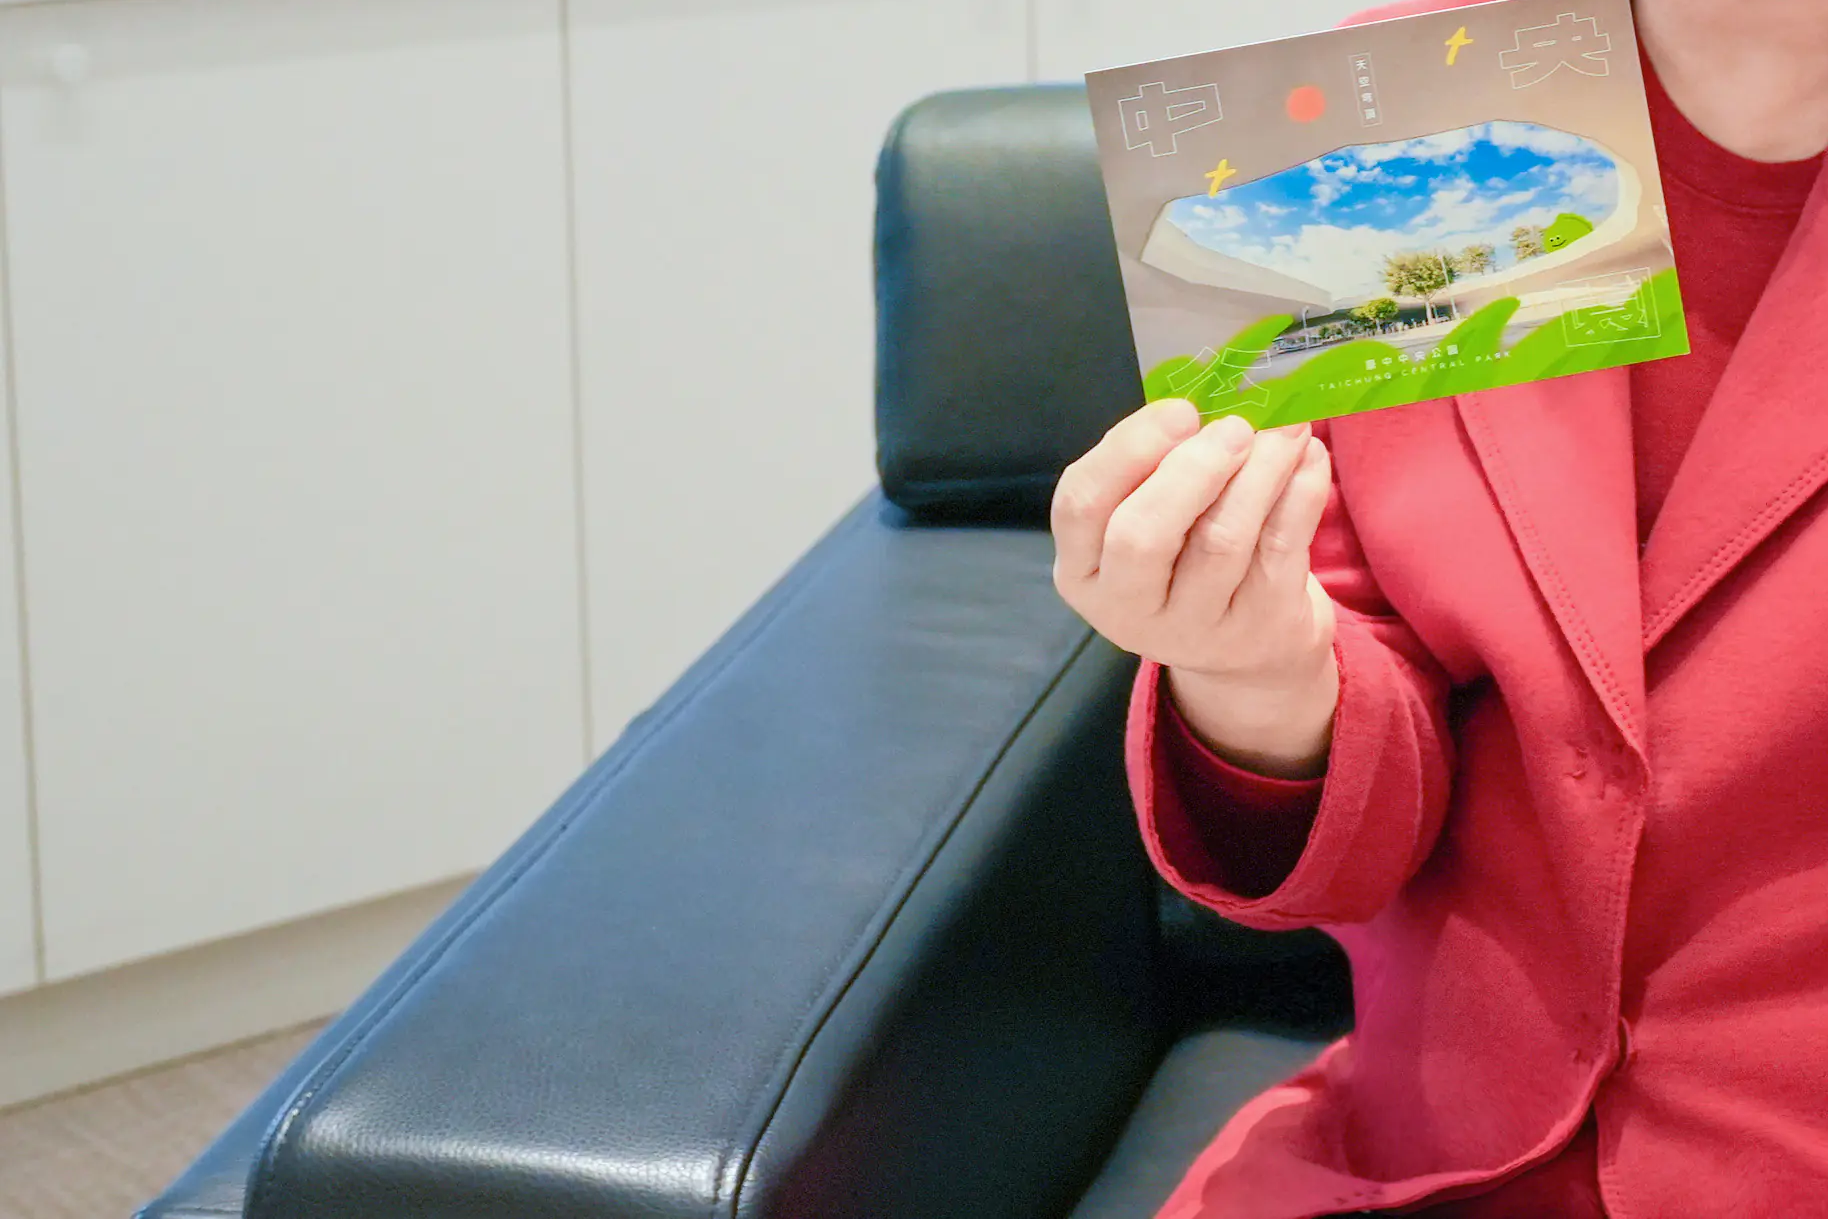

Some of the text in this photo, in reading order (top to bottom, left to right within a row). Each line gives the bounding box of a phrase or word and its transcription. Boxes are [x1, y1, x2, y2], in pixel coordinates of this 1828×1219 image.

[1118, 12, 1611, 158] 中 央
[1401, 358, 1465, 377] CENTRAL
